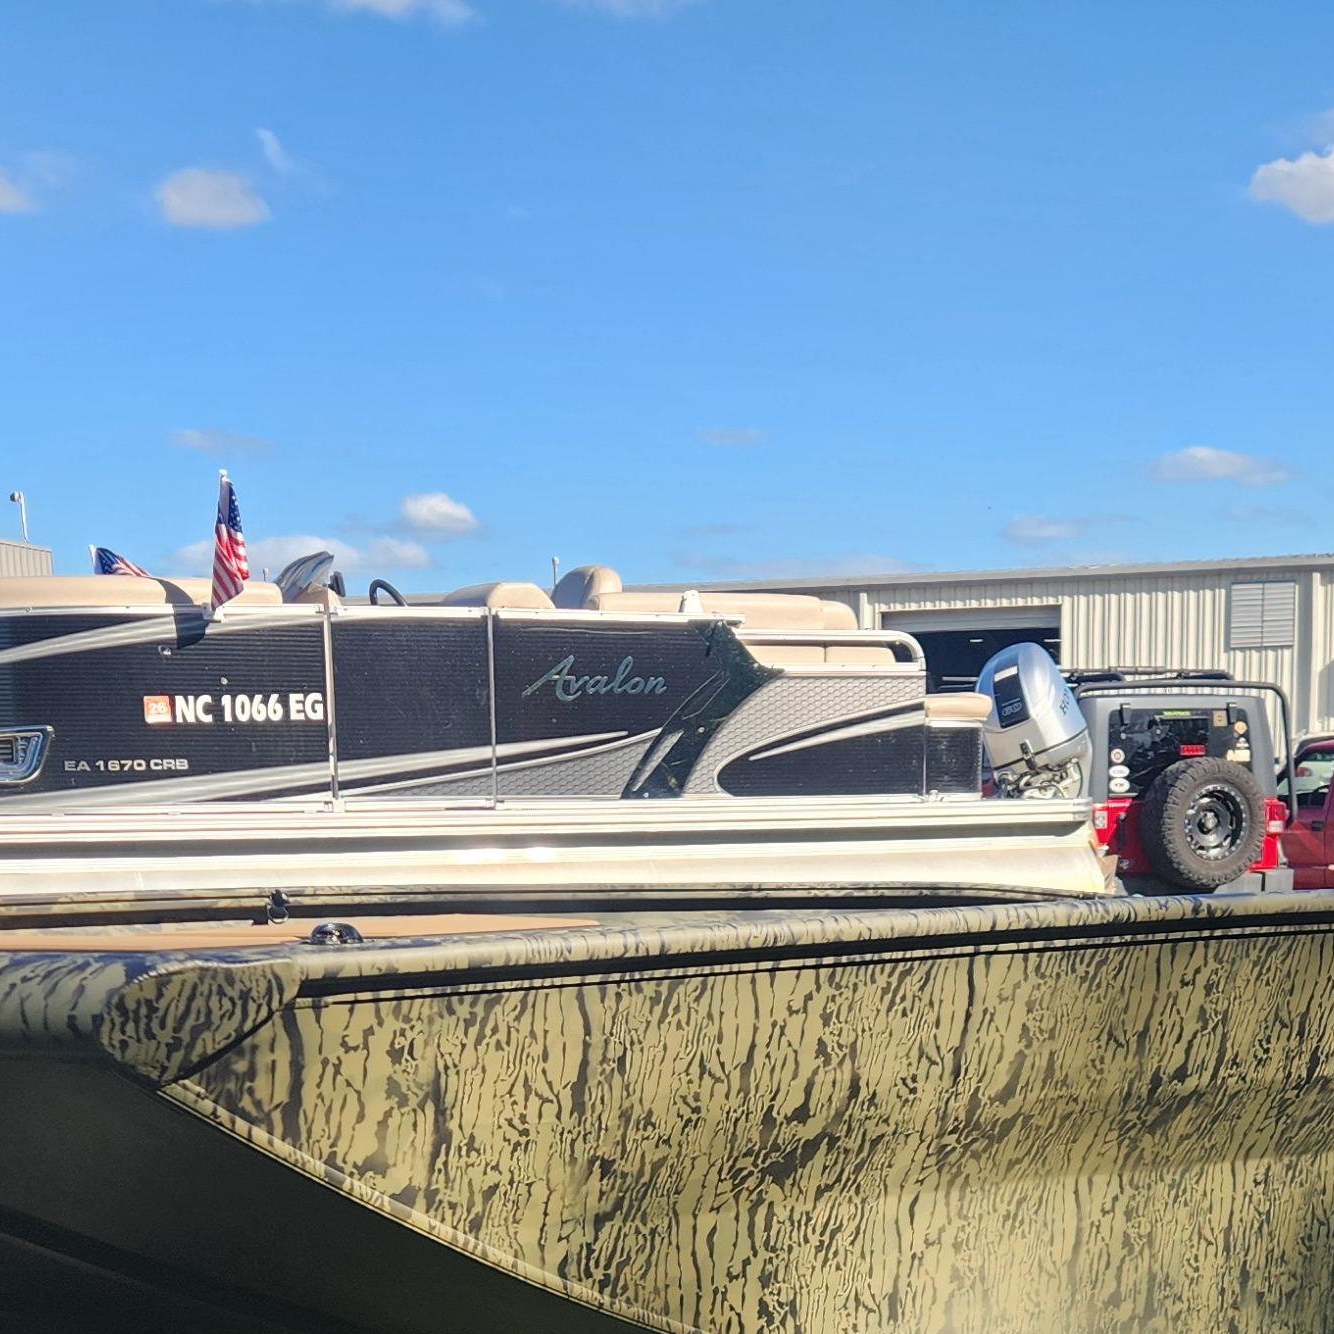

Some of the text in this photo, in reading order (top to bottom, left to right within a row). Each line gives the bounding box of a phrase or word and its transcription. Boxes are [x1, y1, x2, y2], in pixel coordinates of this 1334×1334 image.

[521, 654, 668, 701] Avalon
[174, 692, 325, 724] NC 1066 EG
[64, 758, 190, 772] EA 1670 CRB
